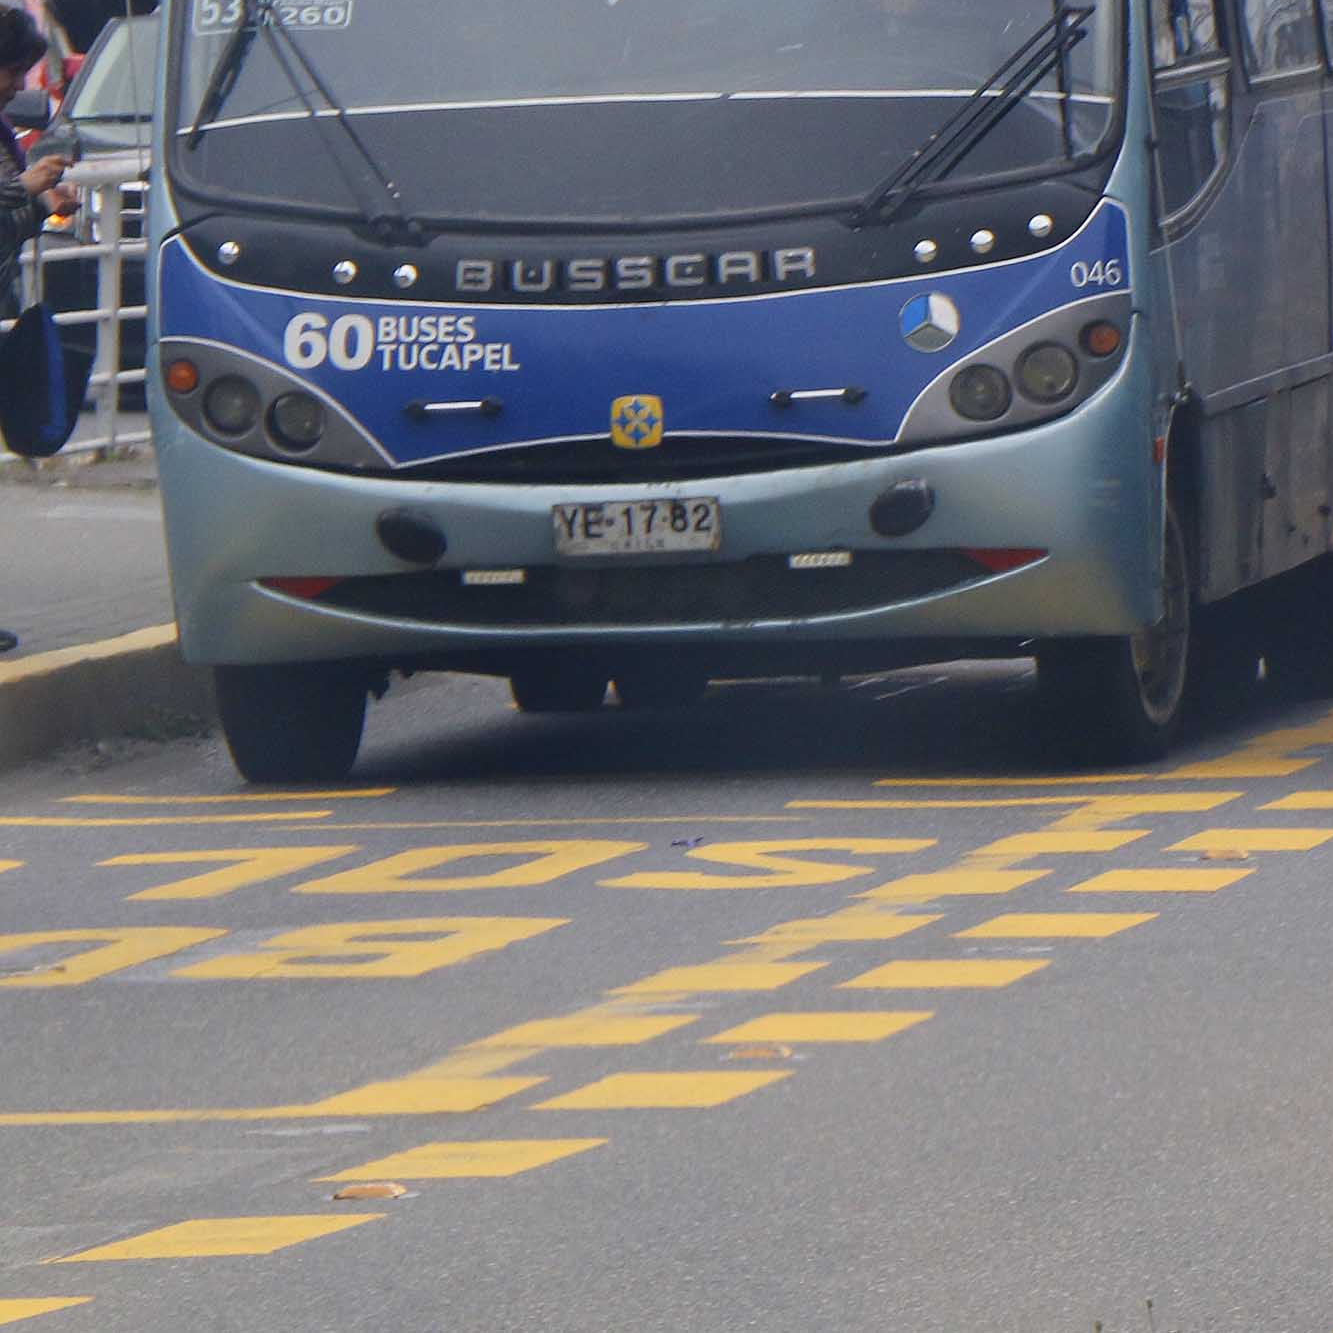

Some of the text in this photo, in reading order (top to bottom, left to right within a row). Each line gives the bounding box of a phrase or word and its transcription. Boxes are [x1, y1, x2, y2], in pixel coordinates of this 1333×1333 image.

[280, 6, 346, 26] 260
[455, 246, 817, 293] BUSSCAR
[1070, 258, 1122, 288] 046
[284, 312, 374, 372] 60
[377, 316, 475, 343] BUSES
[376, 343, 520, 371] TUCAPEL
